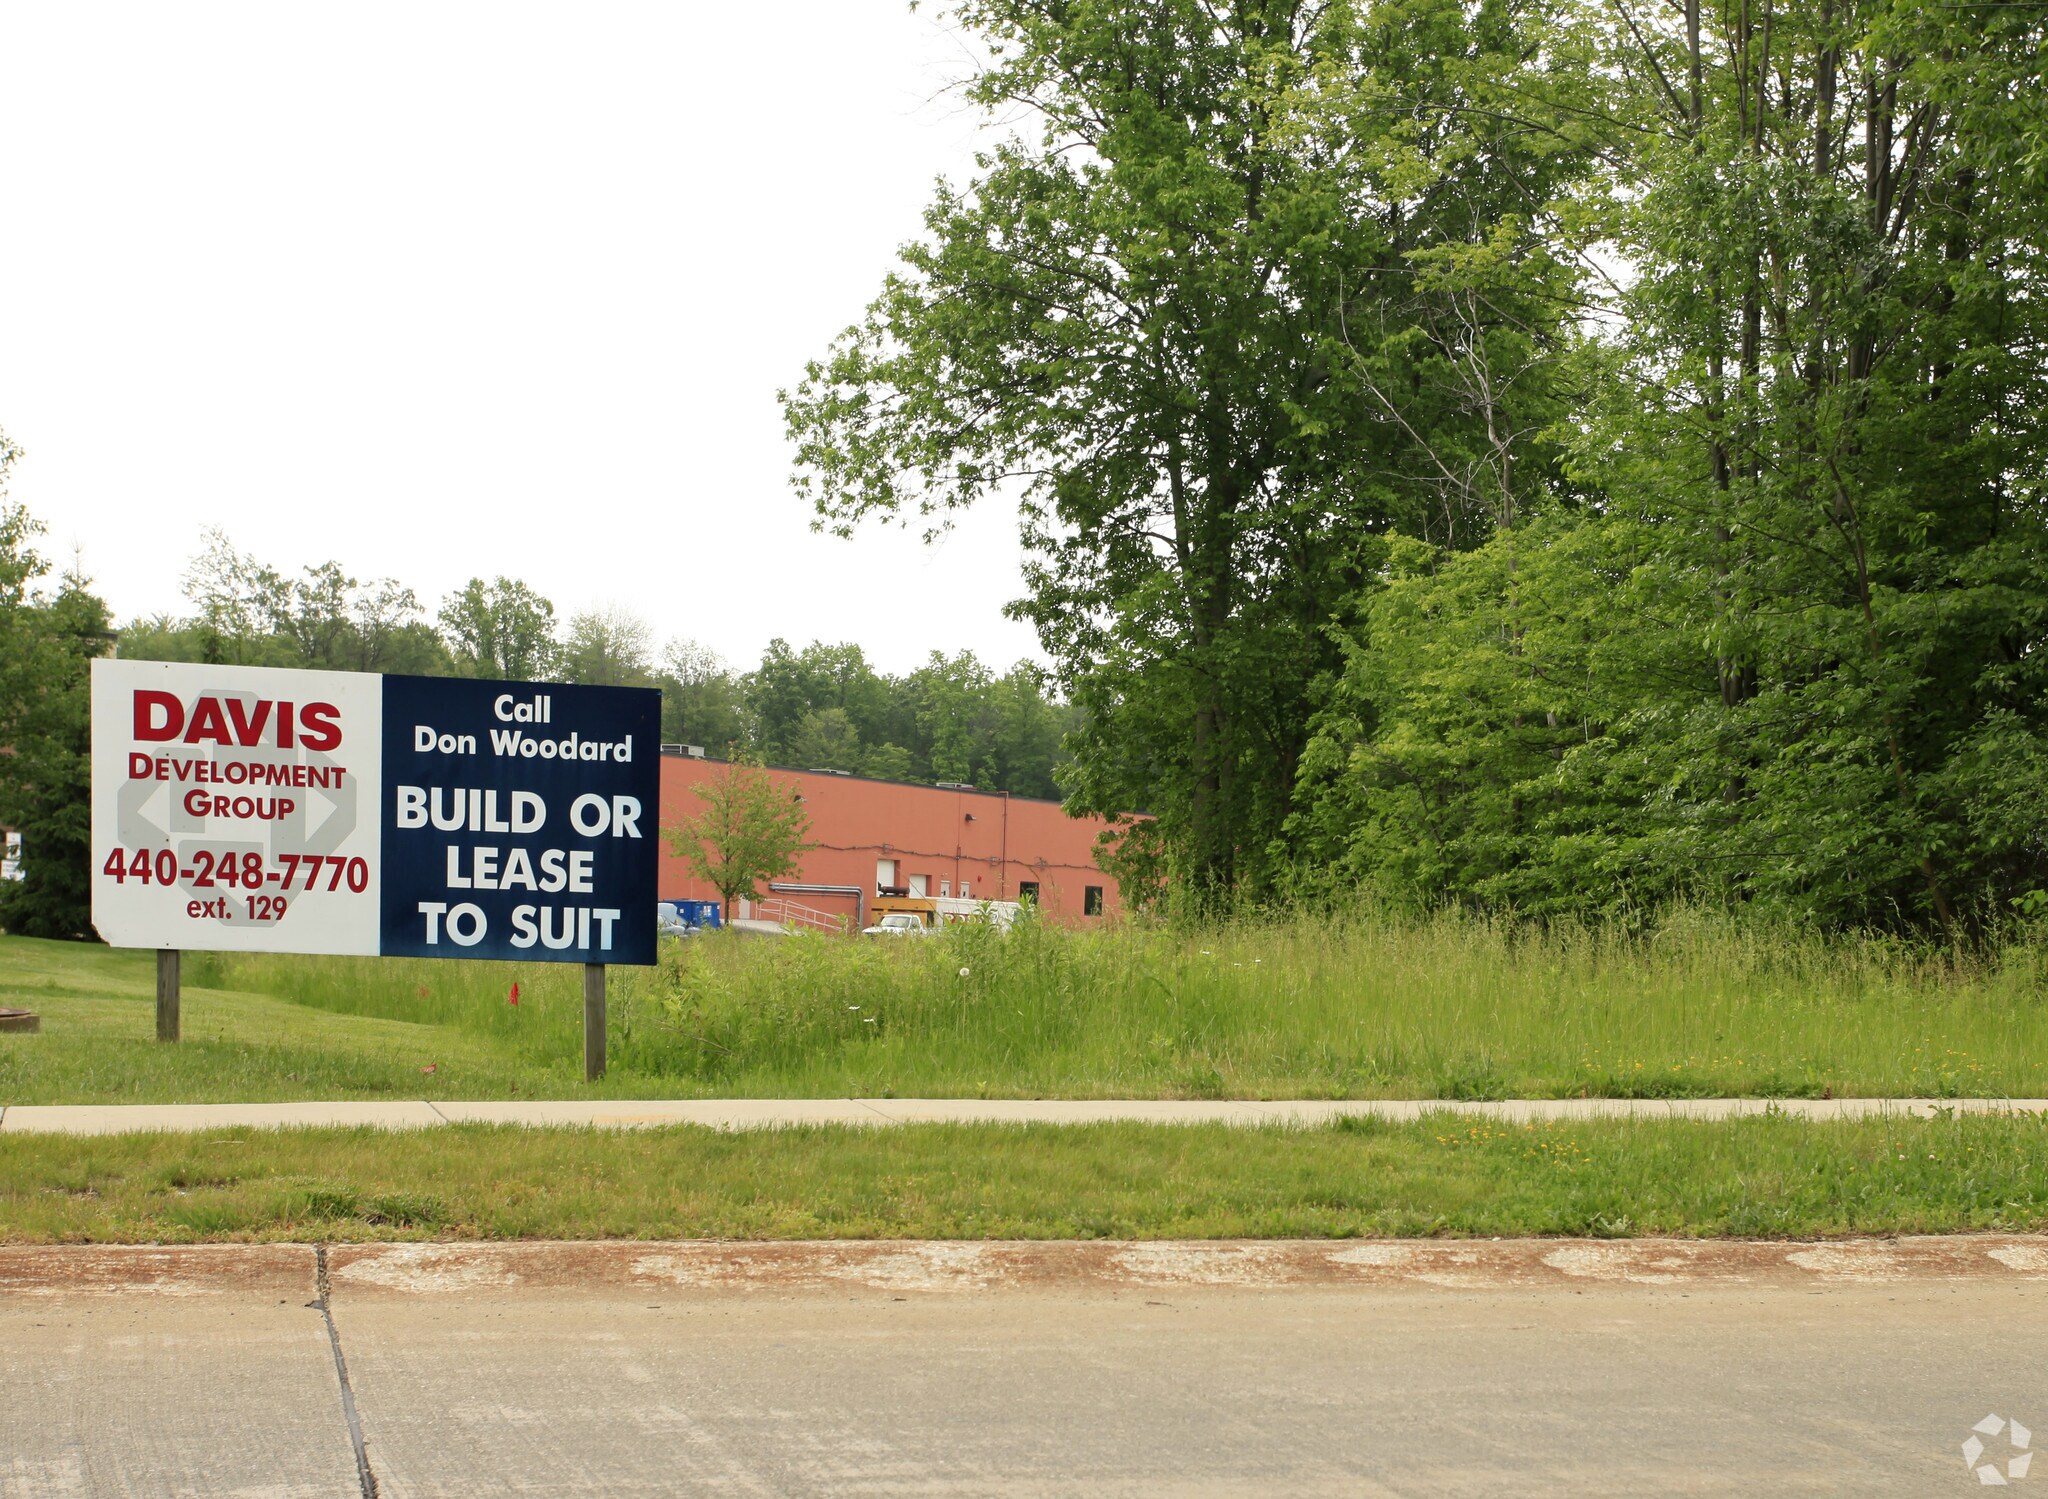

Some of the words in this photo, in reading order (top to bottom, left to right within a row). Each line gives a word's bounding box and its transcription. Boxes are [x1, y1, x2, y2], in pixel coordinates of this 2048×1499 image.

[133, 688, 343, 752] DAVIS
[494, 694, 551, 724] Call
[414, 725, 477, 755] Don
[489, 729, 632, 763] Woodard
[128, 752, 347, 790] DEVELOPMENT
[184, 789, 296, 820] GROUP
[396, 785, 547, 835] BUILD
[569, 793, 643, 839] OR
[103, 848, 369, 894] 440-248-7770
[446, 845, 594, 893] LEASE
[186, 896, 232, 920] ext.
[246, 896, 288, 921] 129
[418, 902, 488, 947] TO
[509, 904, 621, 950] SUIT
